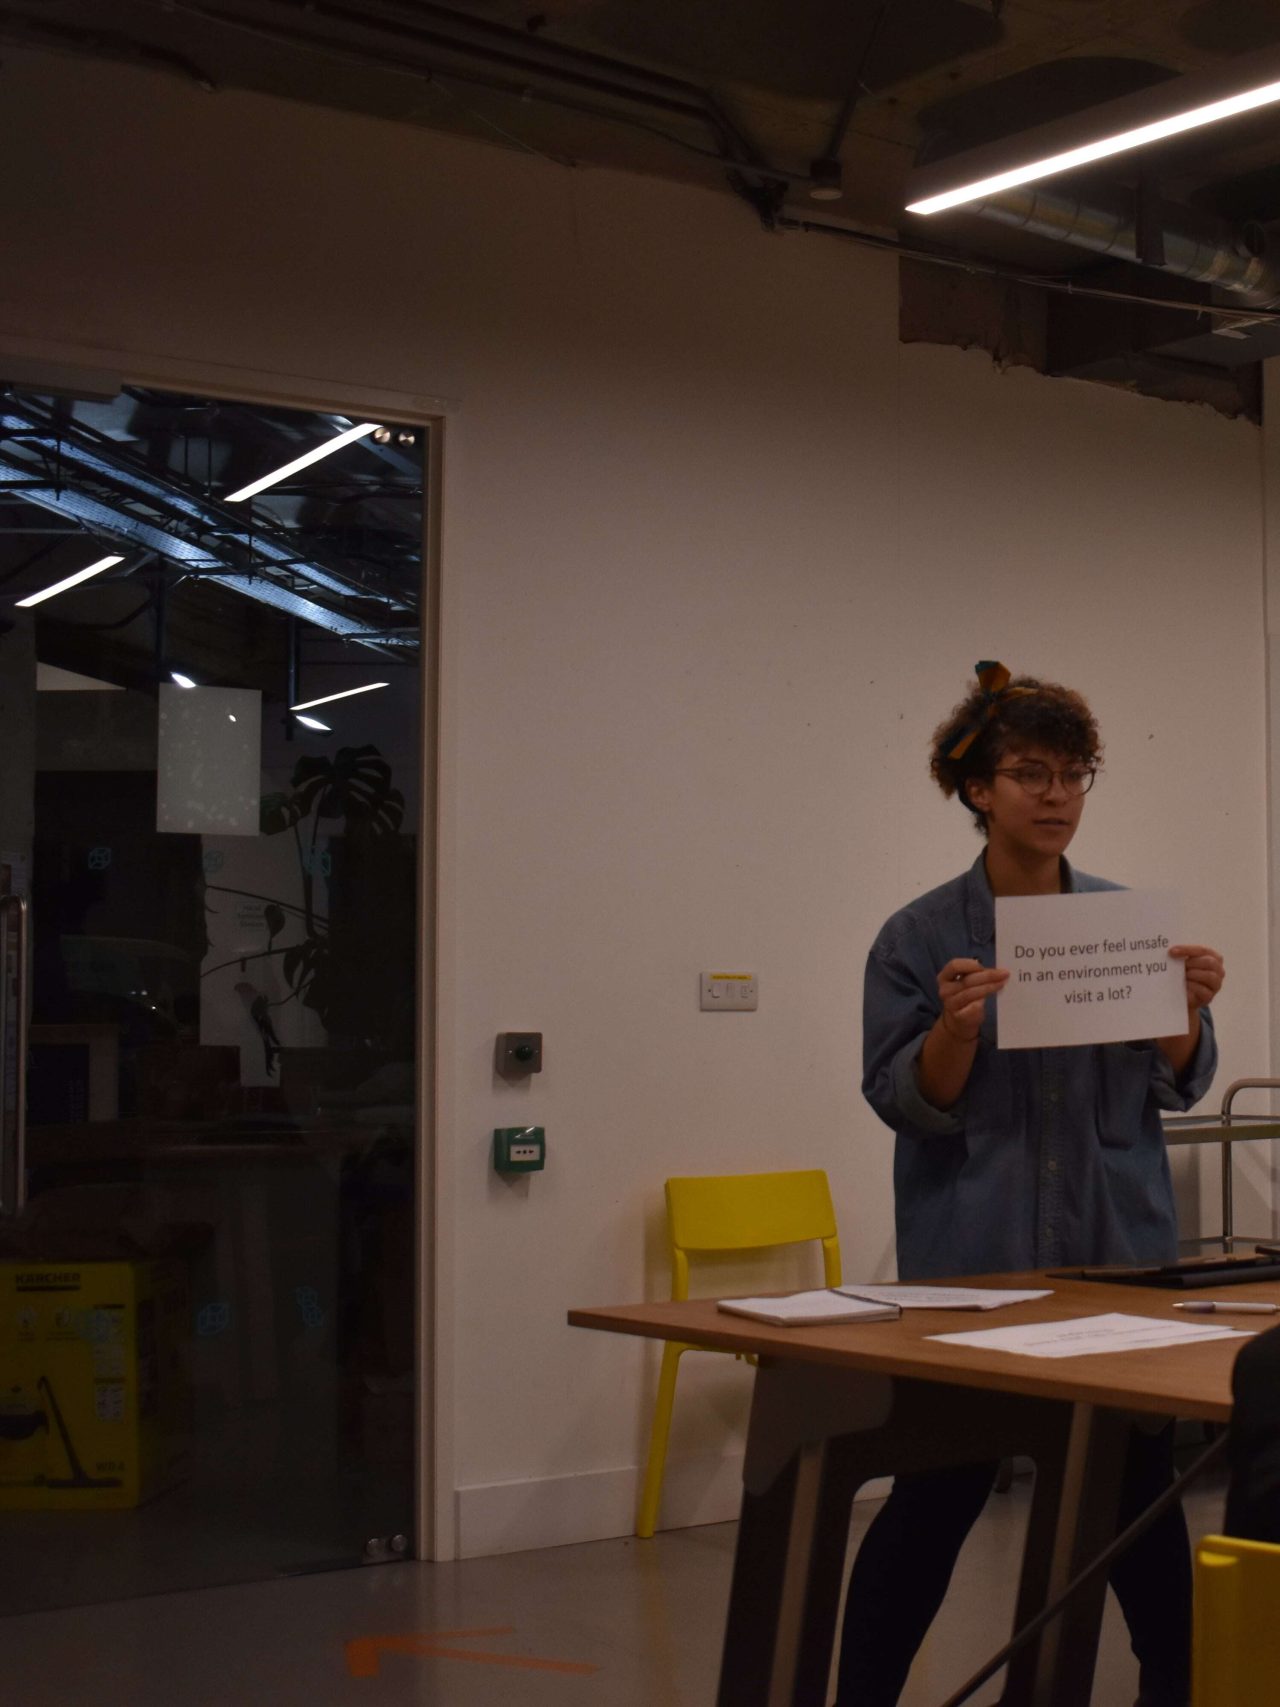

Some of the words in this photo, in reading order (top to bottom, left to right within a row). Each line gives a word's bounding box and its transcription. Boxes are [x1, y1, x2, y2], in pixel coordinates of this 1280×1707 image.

[1015, 945, 1034, 958] Do
[1039, 946, 1065, 960] you
[1070, 942, 1099, 955] ever
[1103, 938, 1126, 953] feel
[1130, 935, 1169, 950] unsafe
[1018, 970, 1031, 982] in
[1036, 971, 1054, 981] an
[1058, 962, 1142, 980] environment
[1146, 962, 1167, 975] you
[1065, 989, 1092, 1003] visit
[1097, 991, 1104, 1001] a
[1108, 985, 1132, 1001] lot?
